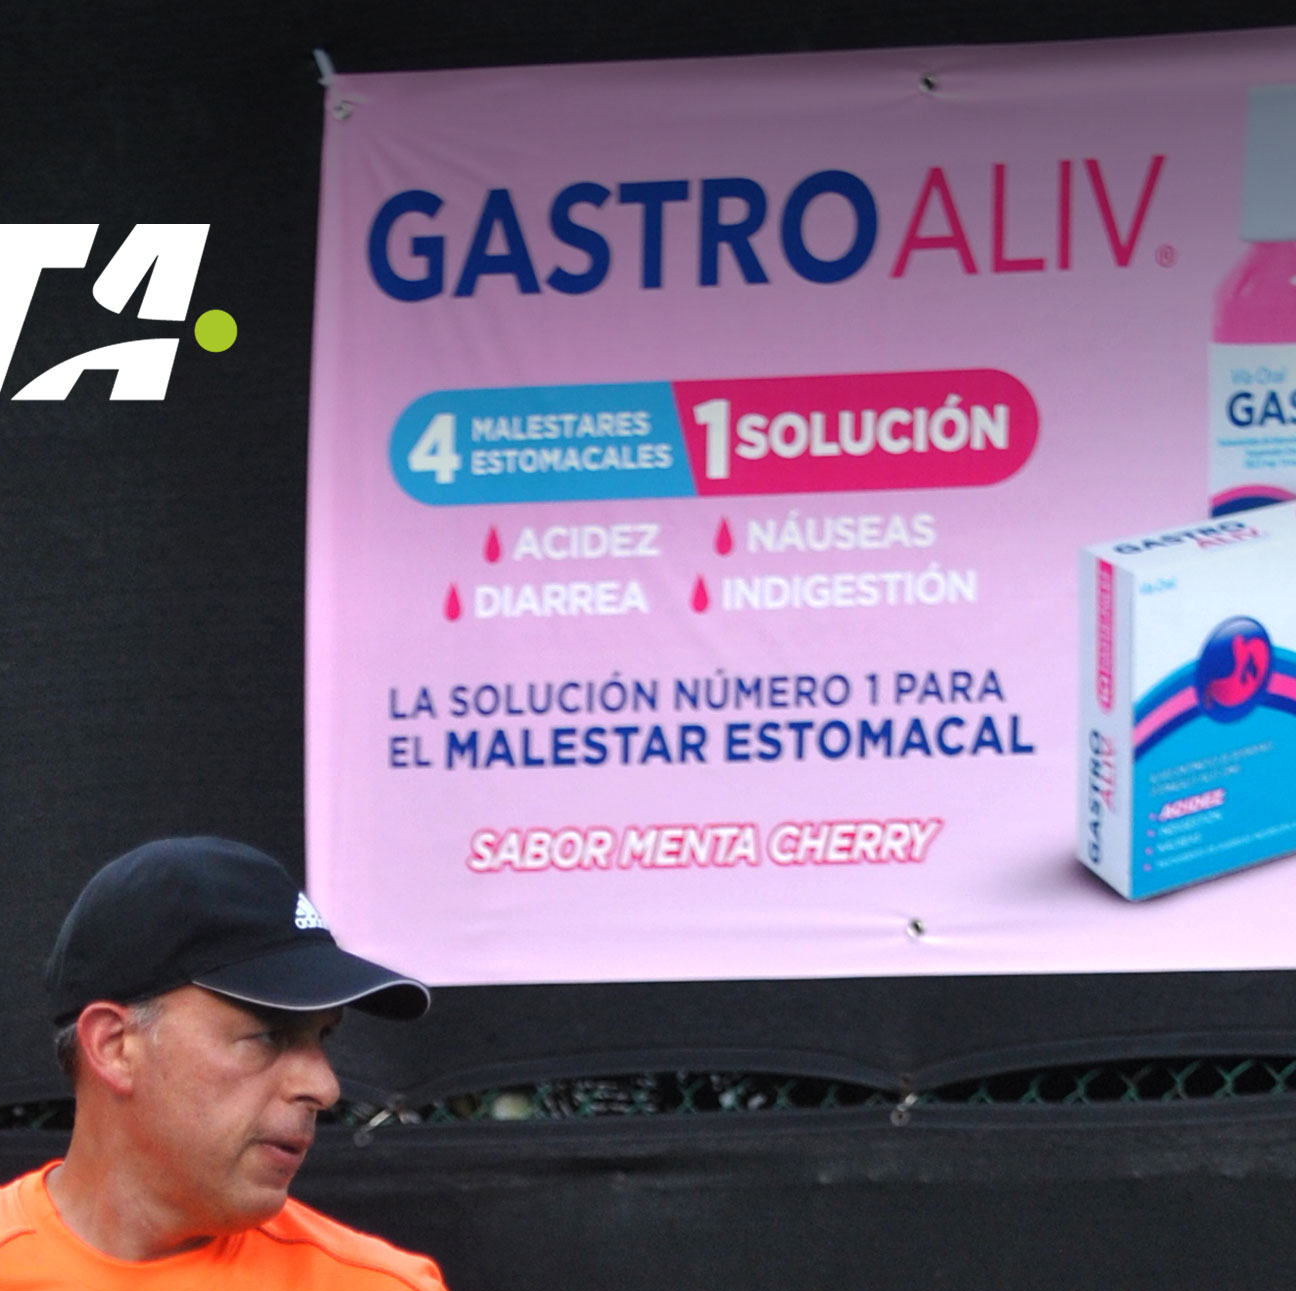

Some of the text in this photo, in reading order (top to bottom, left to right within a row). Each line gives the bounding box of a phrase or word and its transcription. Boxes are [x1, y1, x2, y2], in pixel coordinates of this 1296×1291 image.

[408, 412, 461, 484] 4
[471, 411, 652, 441] MALESTARES
[693, 393, 1010, 480] 1 SOLUCIÓN
[470, 444, 674, 475] ESTOMACALES
[512, 523, 661, 561] ACIDEZ
[747, 508, 935, 553] NÁUSEAS
[474, 579, 650, 619] DIARREA
[722, 560, 978, 611] INDIGESTIÓN
[389, 667, 1004, 719] LA SOLUCIÓN NÚMERO 1 PARA
[389, 714, 1035, 770] EL MALESTAR ESTOMACAL
[466, 818, 944, 873] SABOR MENTA CHERRY
